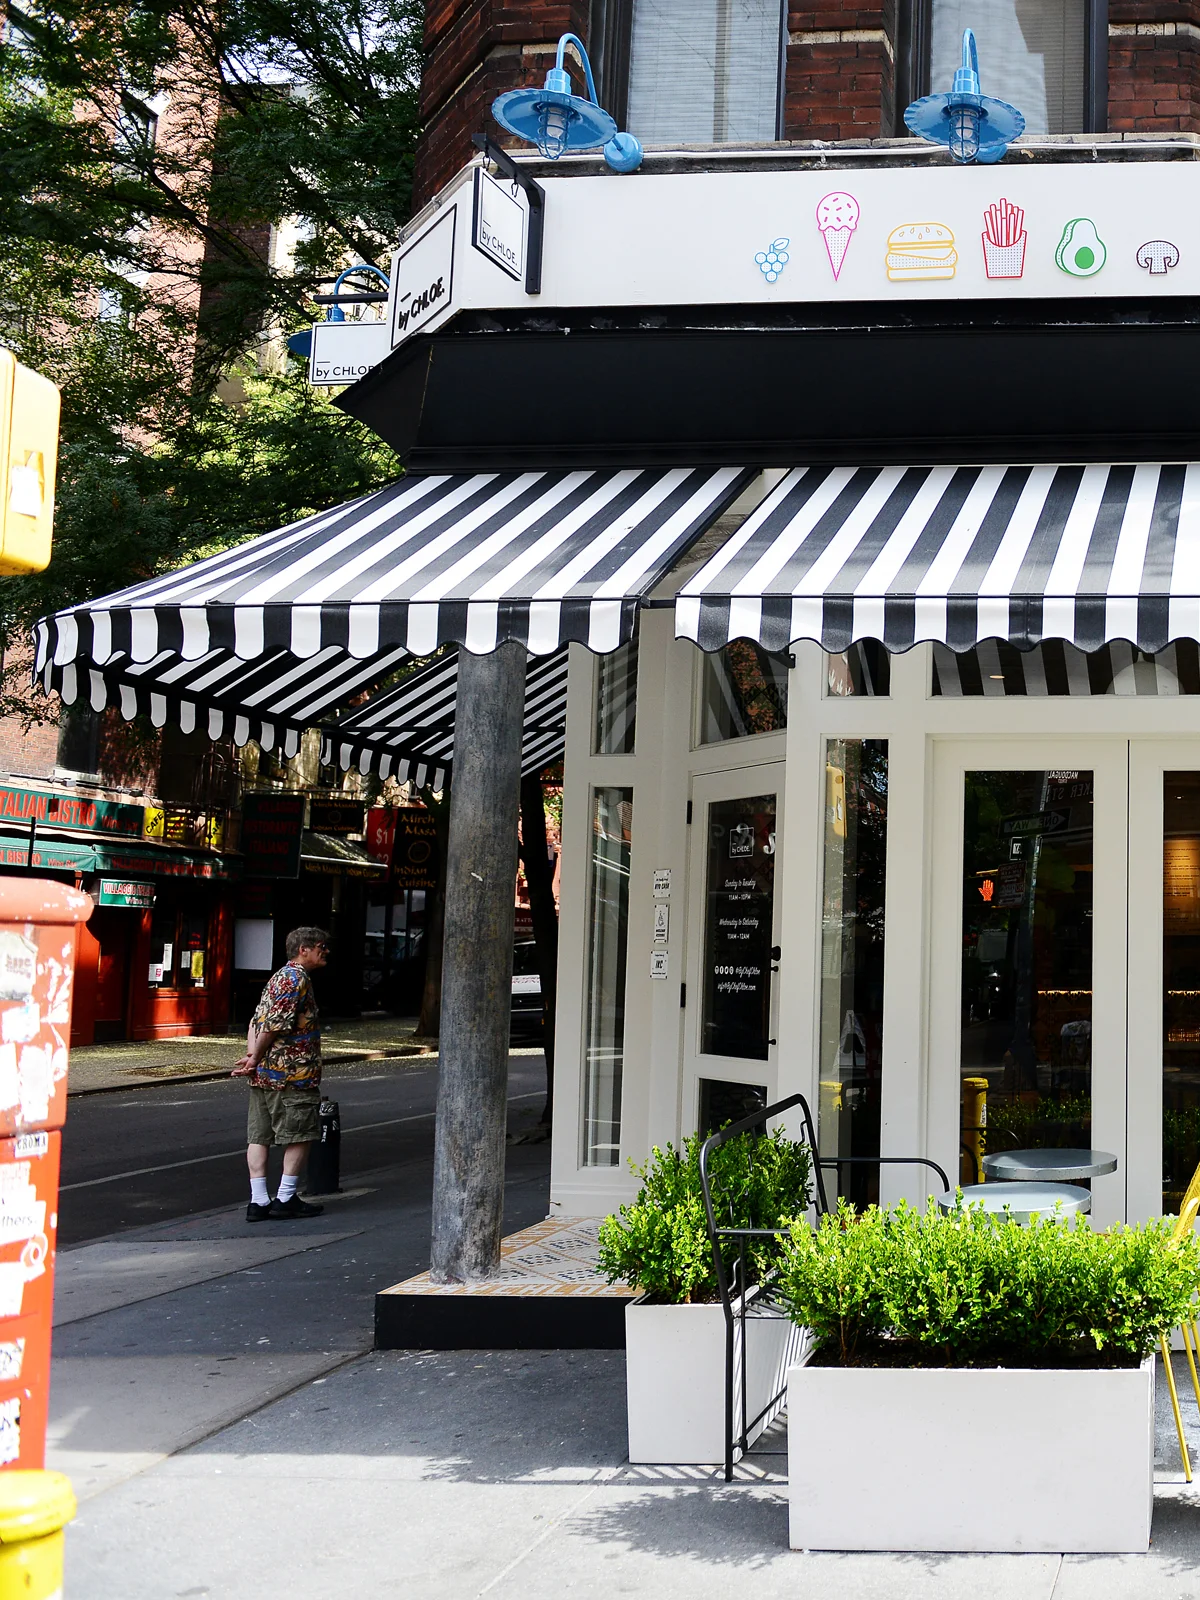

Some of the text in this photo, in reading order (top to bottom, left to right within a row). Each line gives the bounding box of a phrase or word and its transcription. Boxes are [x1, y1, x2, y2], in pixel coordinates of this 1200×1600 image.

[482, 229, 518, 267] by CHLOE.
[398, 307, 411, 331] by
[316, 367, 330, 379] by
[145, 811, 164, 834] CAFE
[401, 813, 435, 825] Mirch
[405, 825, 436, 836] Masa
[394, 864, 428, 876] Indian
[103, 882, 136, 895] VILLAGGIO
[398, 877, 436, 888] Cuisine
